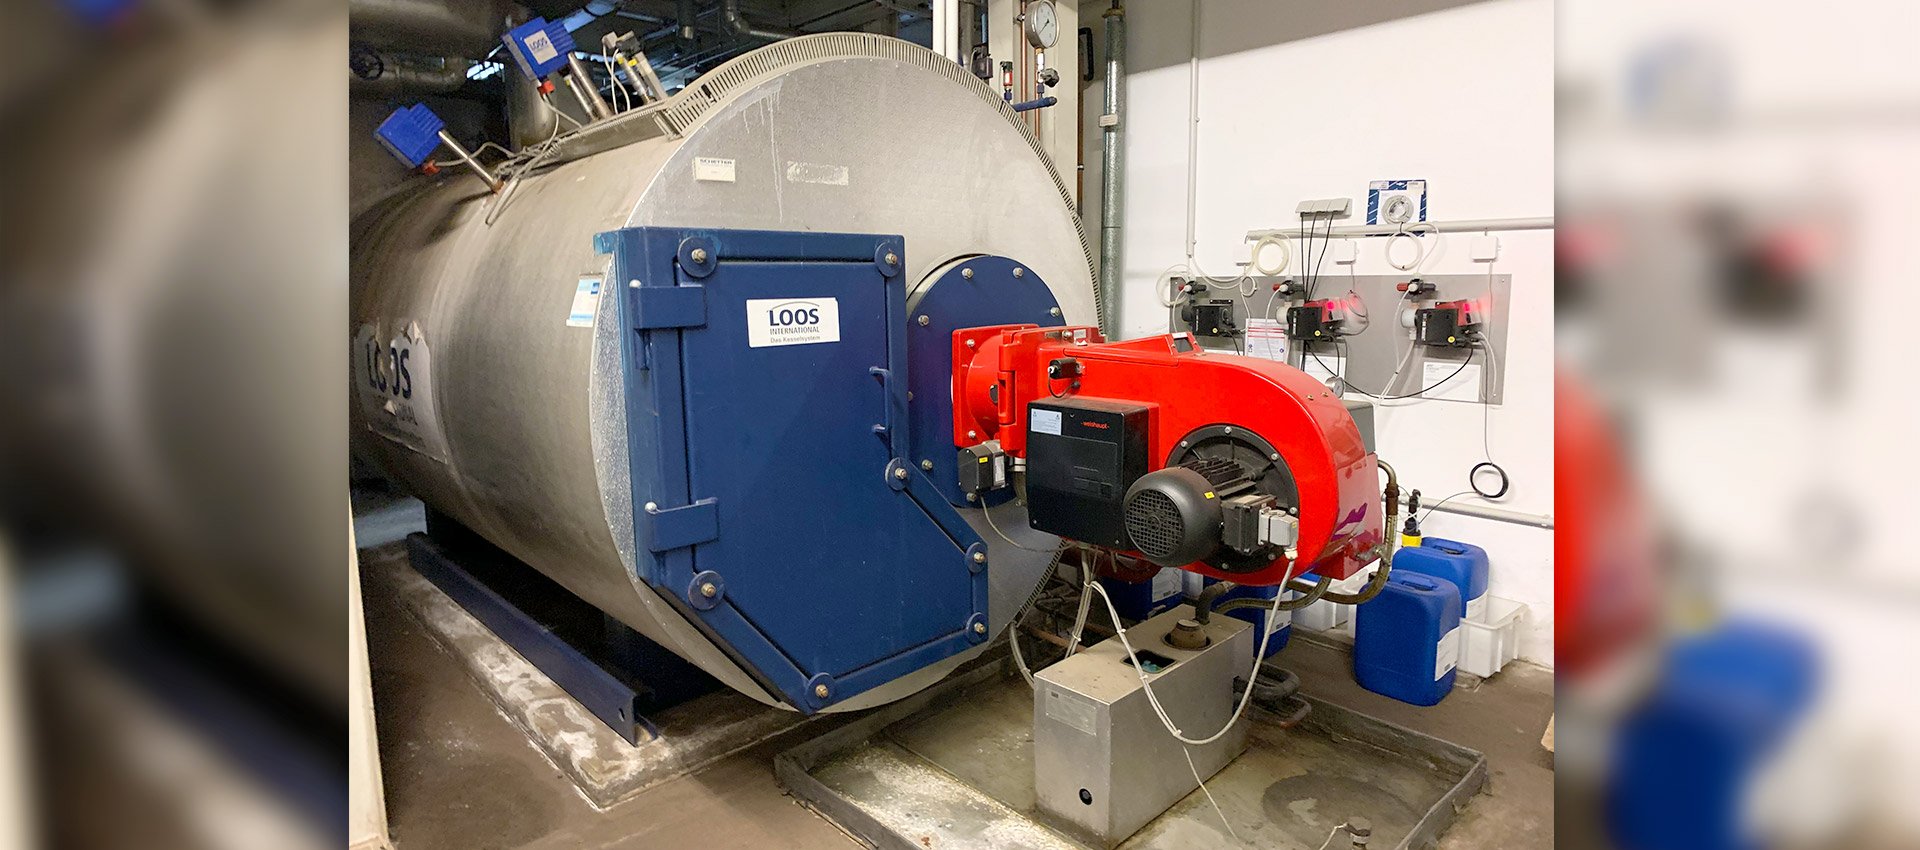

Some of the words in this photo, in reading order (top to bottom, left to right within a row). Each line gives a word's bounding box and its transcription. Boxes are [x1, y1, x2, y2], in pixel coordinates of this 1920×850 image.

[769, 308, 820, 326] LOOS
[769, 326, 820, 335] INTERNATIONAL
[770, 336, 782, 344] Das
[783, 334, 821, 343] Kesselsystem
